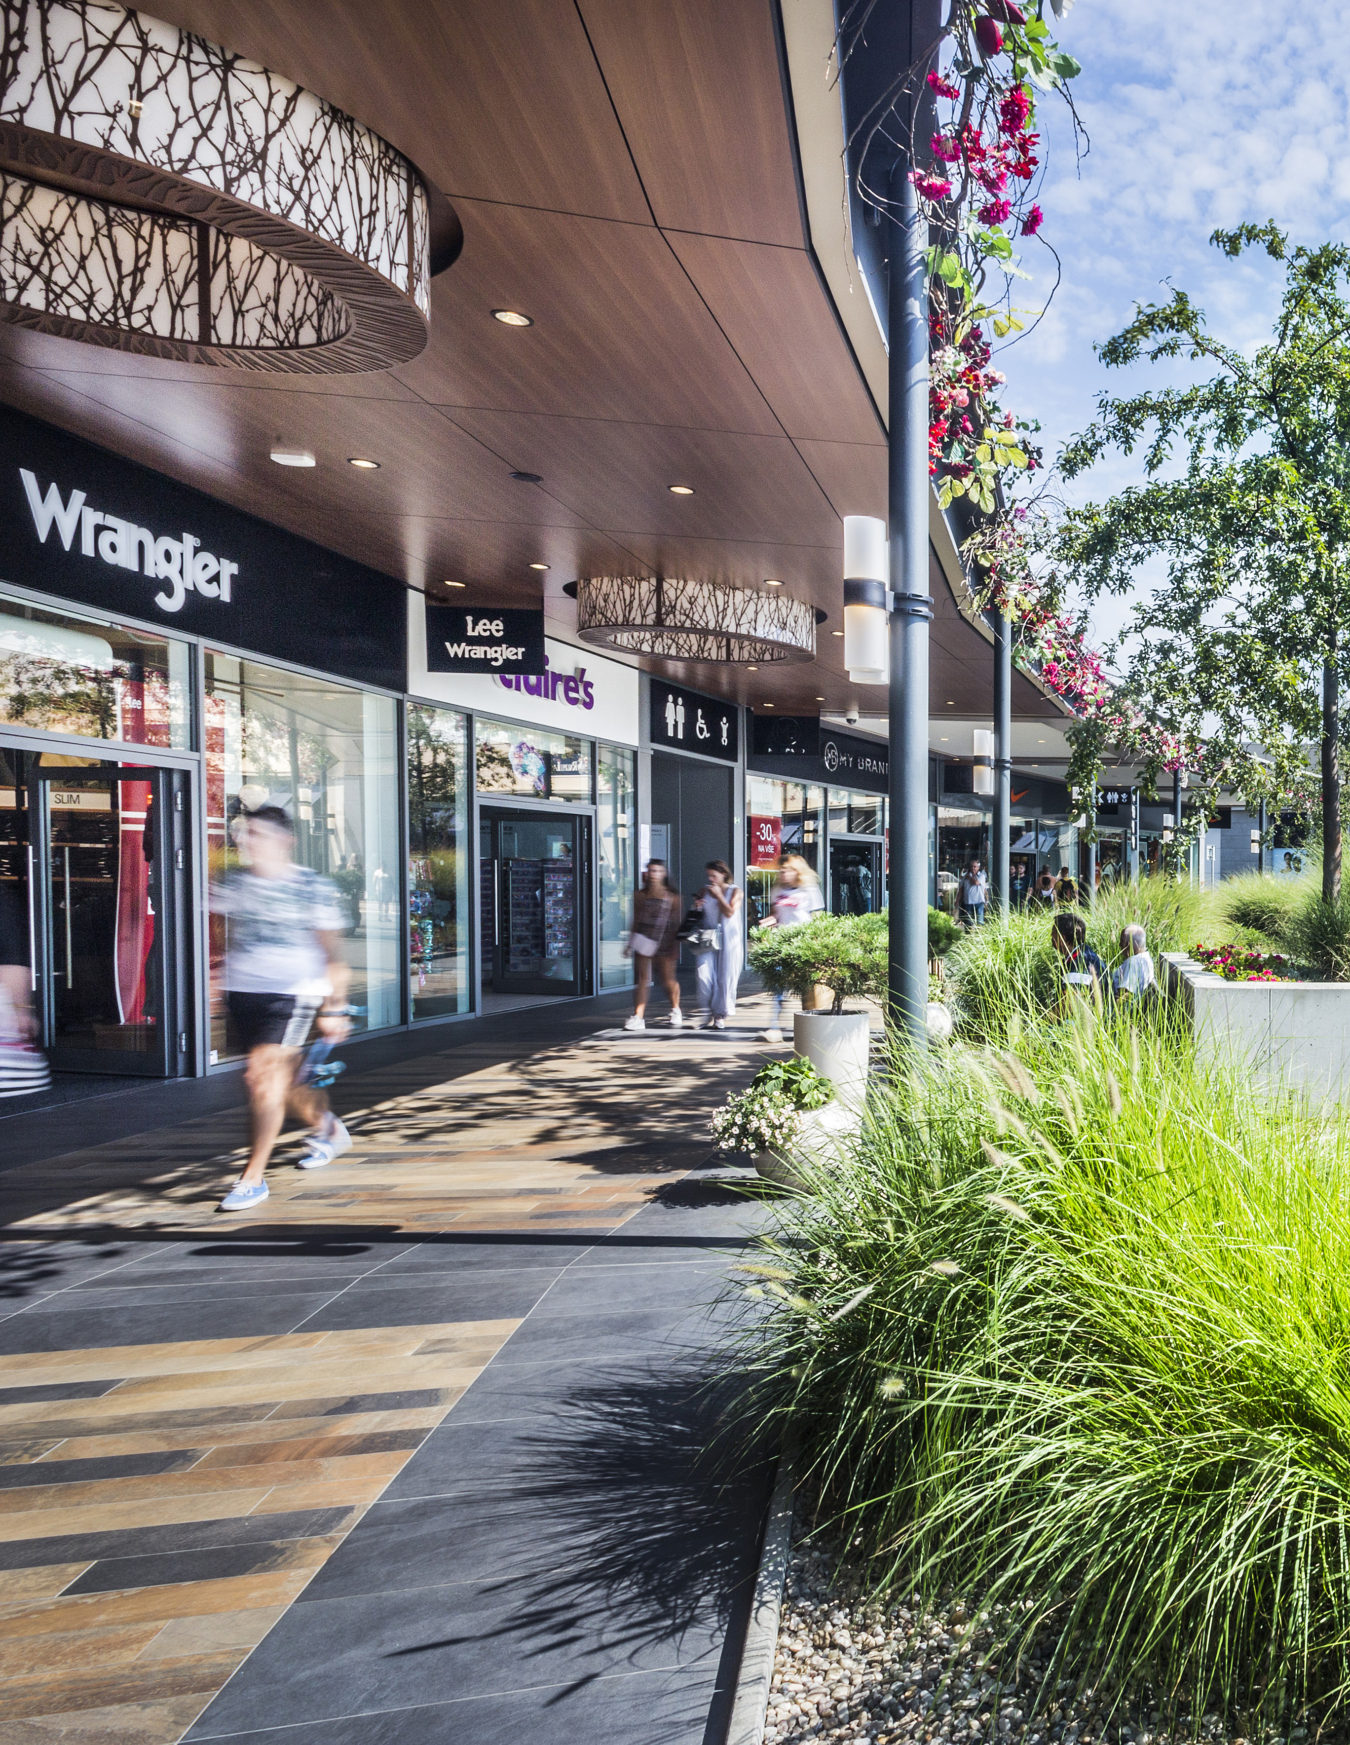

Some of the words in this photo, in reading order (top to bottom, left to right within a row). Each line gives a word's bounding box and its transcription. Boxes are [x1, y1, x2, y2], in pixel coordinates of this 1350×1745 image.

[19, 467, 239, 612] Wrangler
[465, 615, 504, 637] Lee
[445, 642, 525, 666] Wrangler
[54, 793, 80, 804] SLIM
